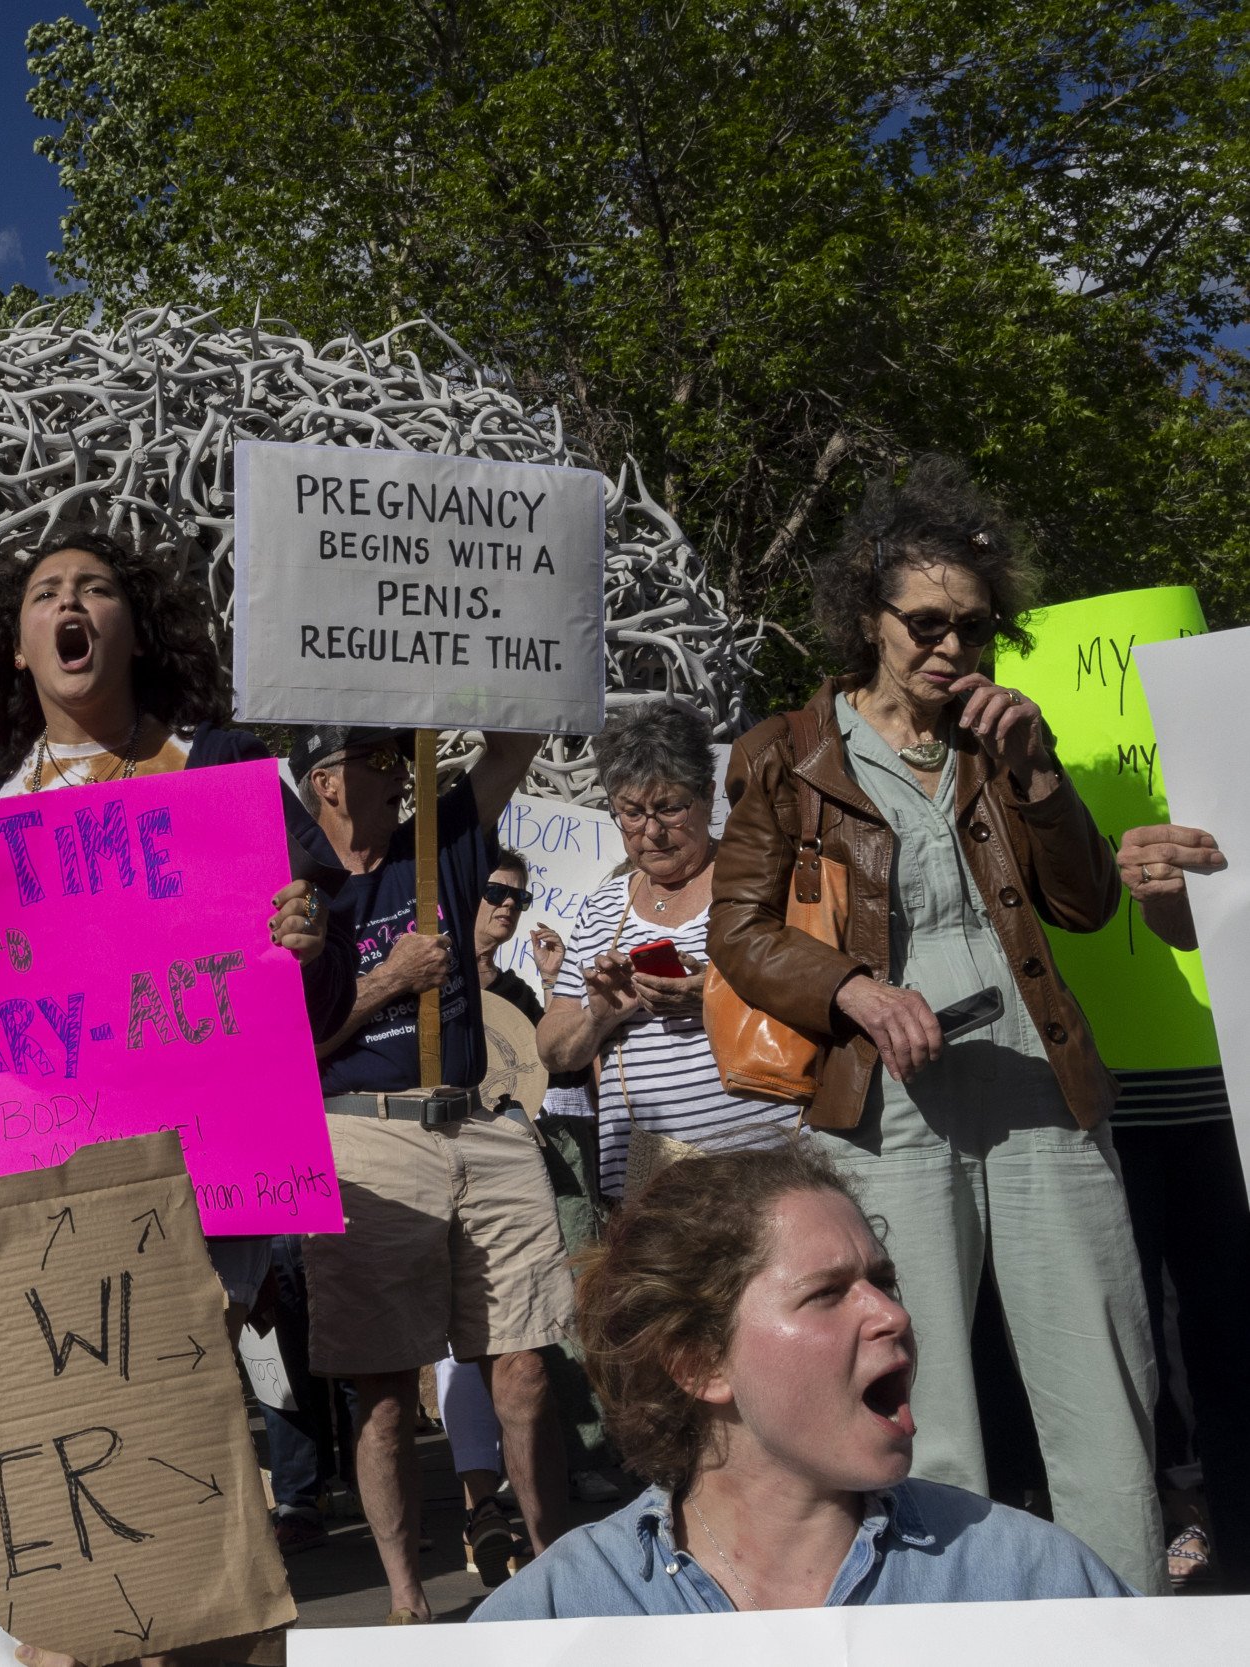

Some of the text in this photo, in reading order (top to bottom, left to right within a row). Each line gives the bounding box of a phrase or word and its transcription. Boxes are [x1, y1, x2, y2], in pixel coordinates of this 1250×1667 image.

[296, 474, 547, 533] PREGNANCY
[319, 530, 555, 575] BEGINS WITH A
[378, 580, 501, 620] PENIS.
[300, 625, 562, 672] REGULATE THAT.
[1076, 634, 1136, 716] MY
[1116, 743, 1157, 796] MY
[497, 800, 613, 861] ABORT
[364, 1024, 416, 1044] Presented by
[2, 1090, 101, 1141] BODY
[253, 1165, 333, 1217] Rights
